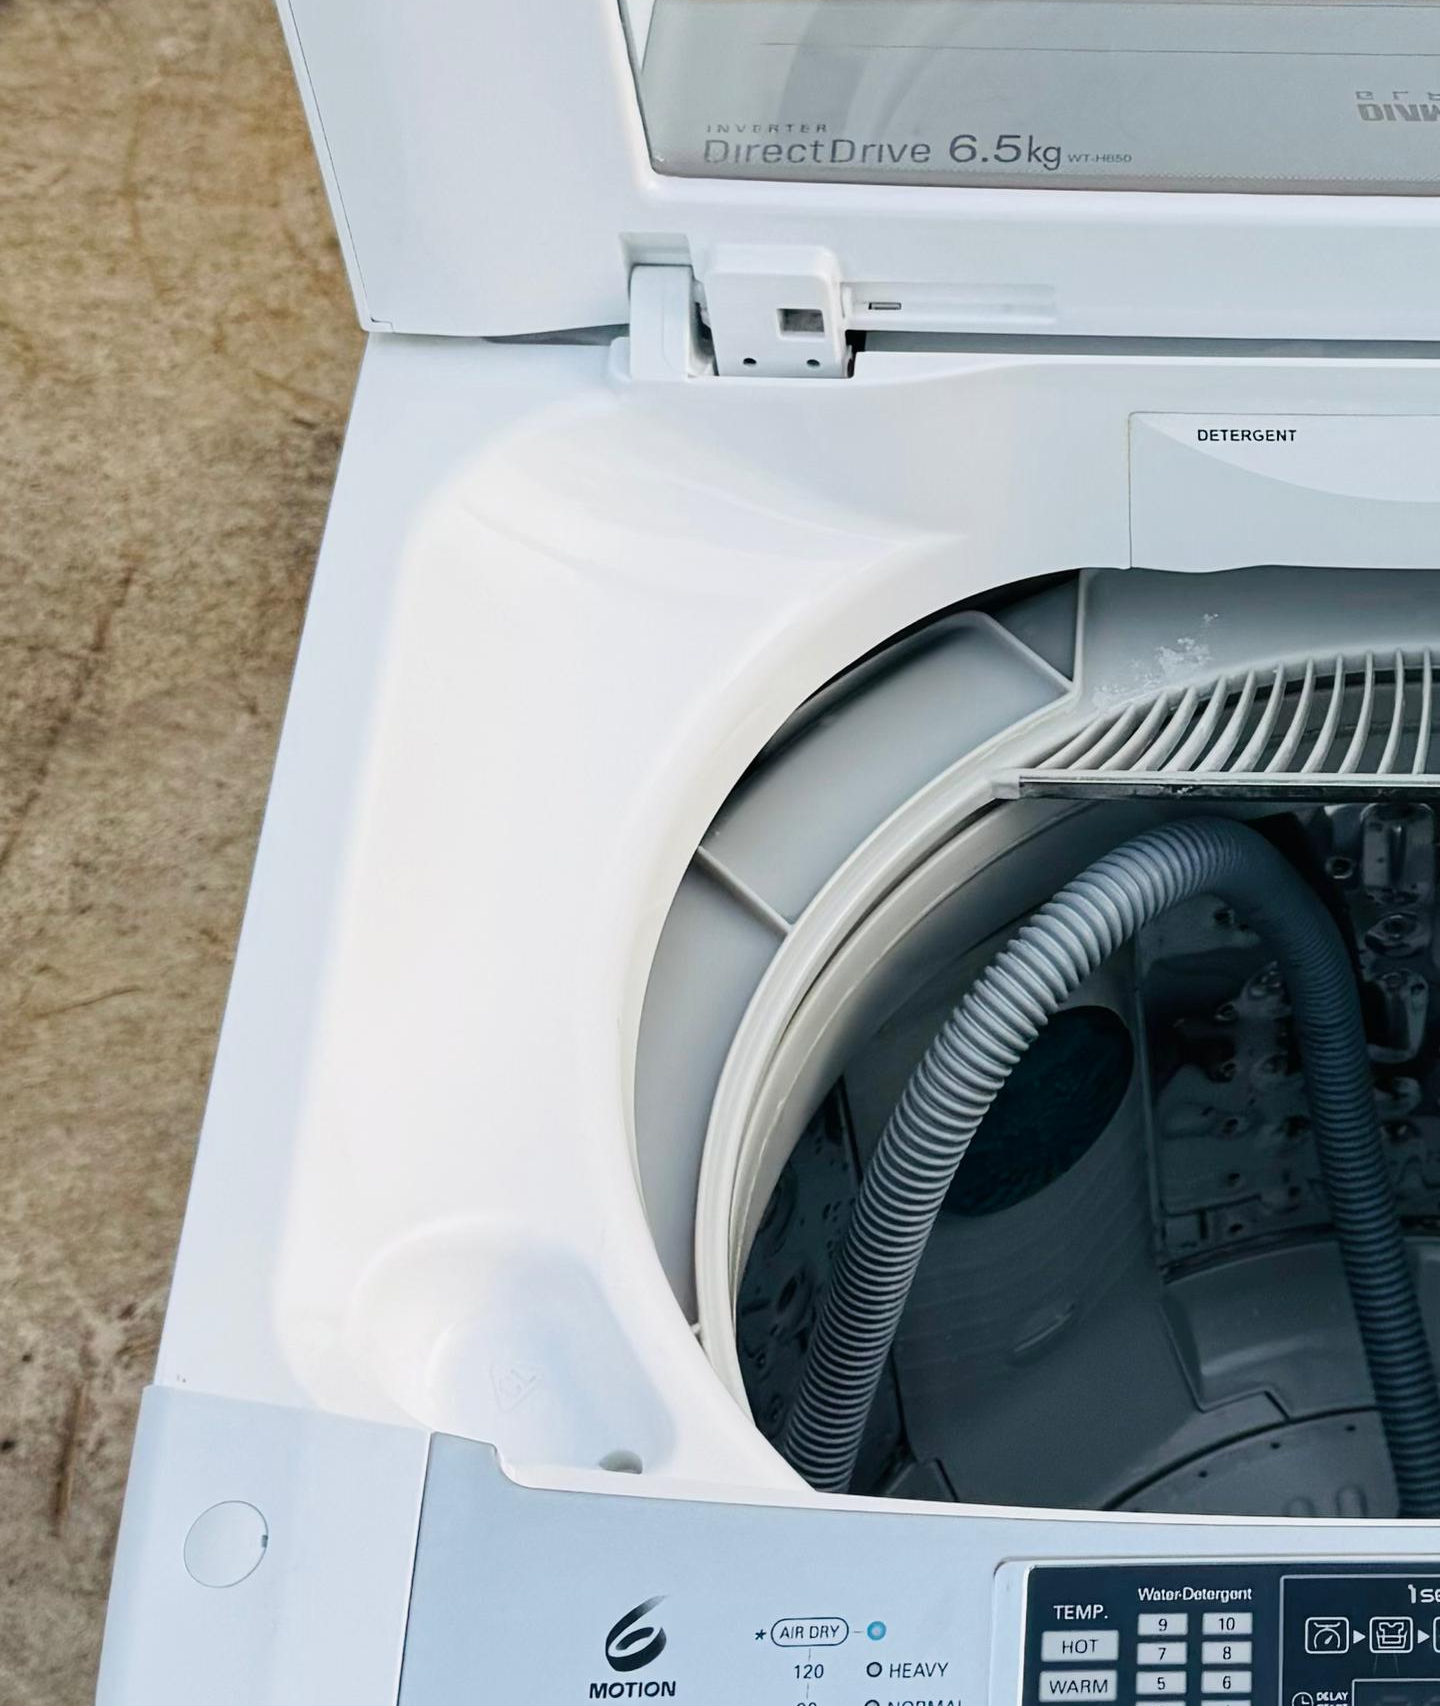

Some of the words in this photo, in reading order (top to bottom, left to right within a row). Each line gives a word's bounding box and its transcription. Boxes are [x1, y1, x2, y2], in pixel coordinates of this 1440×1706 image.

[704, 121, 829, 134] INVERTER
[946, 131, 1062, 171] 6.5kg
[1196, 427, 1297, 443] DETERGENT
[1053, 1604, 1108, 1620] TEMP.
[1158, 1618, 1168, 1633] 9
[1219, 1617, 1236, 1631] 10
[779, 1624, 804, 1639] AIR
[809, 1624, 840, 1640] DRY
[1062, 1639, 1097, 1655] HOT
[1158, 1647, 1167, 1661] 7
[1222, 1646, 1232, 1661] 8
[793, 1664, 825, 1680] 120
[888, 1662, 950, 1678] HEAVY
[589, 1681, 676, 1699] MOTION
[1049, 1679, 1109, 1694] WARM
[1156, 1676, 1166, 1691] 5
[1222, 1676, 1232, 1690] 6
[1316, 1692, 1348, 1701] DELAY
